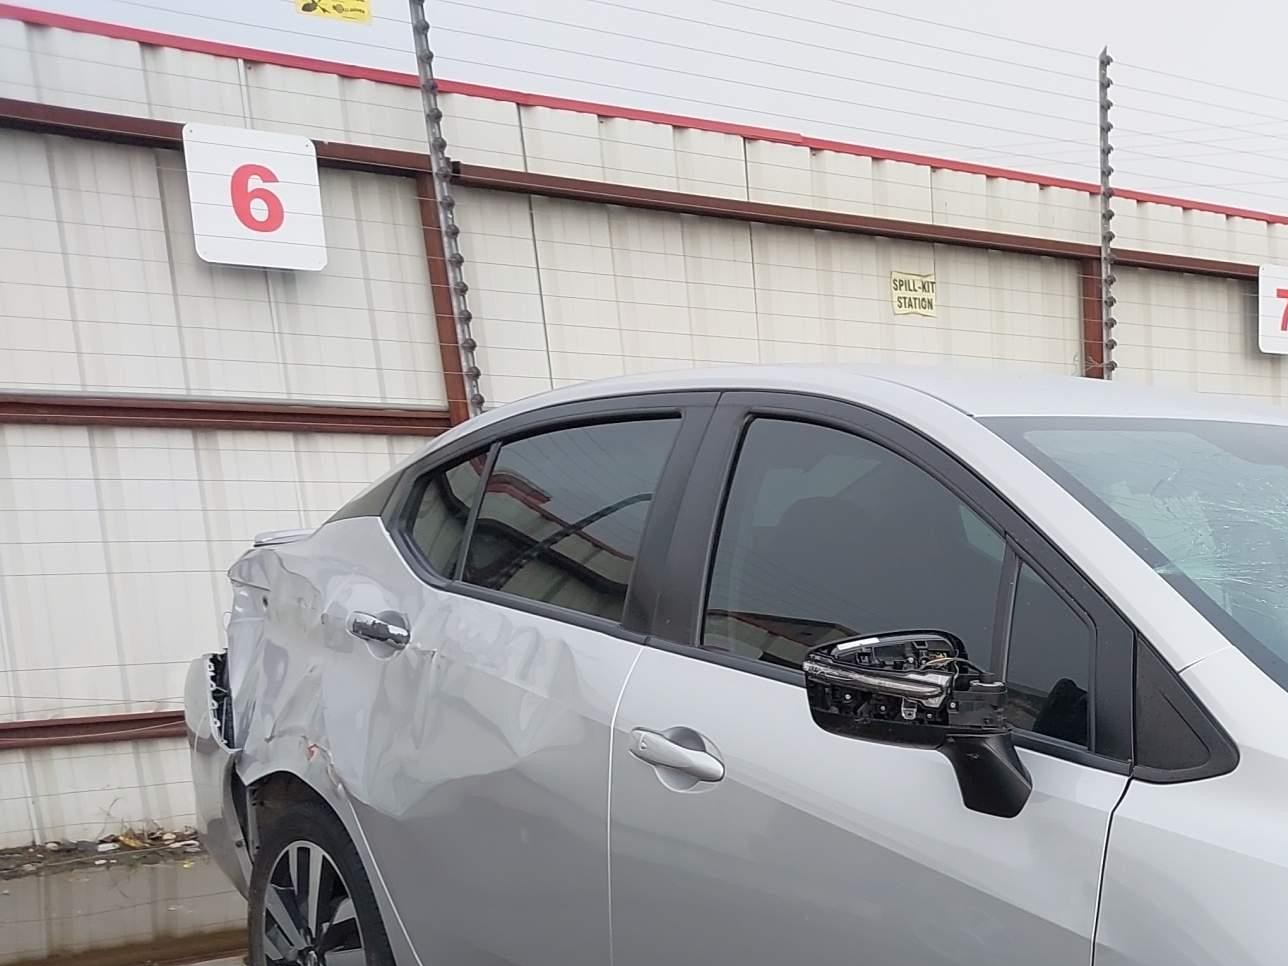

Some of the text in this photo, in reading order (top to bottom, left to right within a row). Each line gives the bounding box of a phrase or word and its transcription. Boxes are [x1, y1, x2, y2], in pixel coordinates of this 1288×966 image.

[230, 163, 285, 233] 6
[892, 278, 937, 294] SPILL-KIT
[897, 296, 934, 310] STATION
